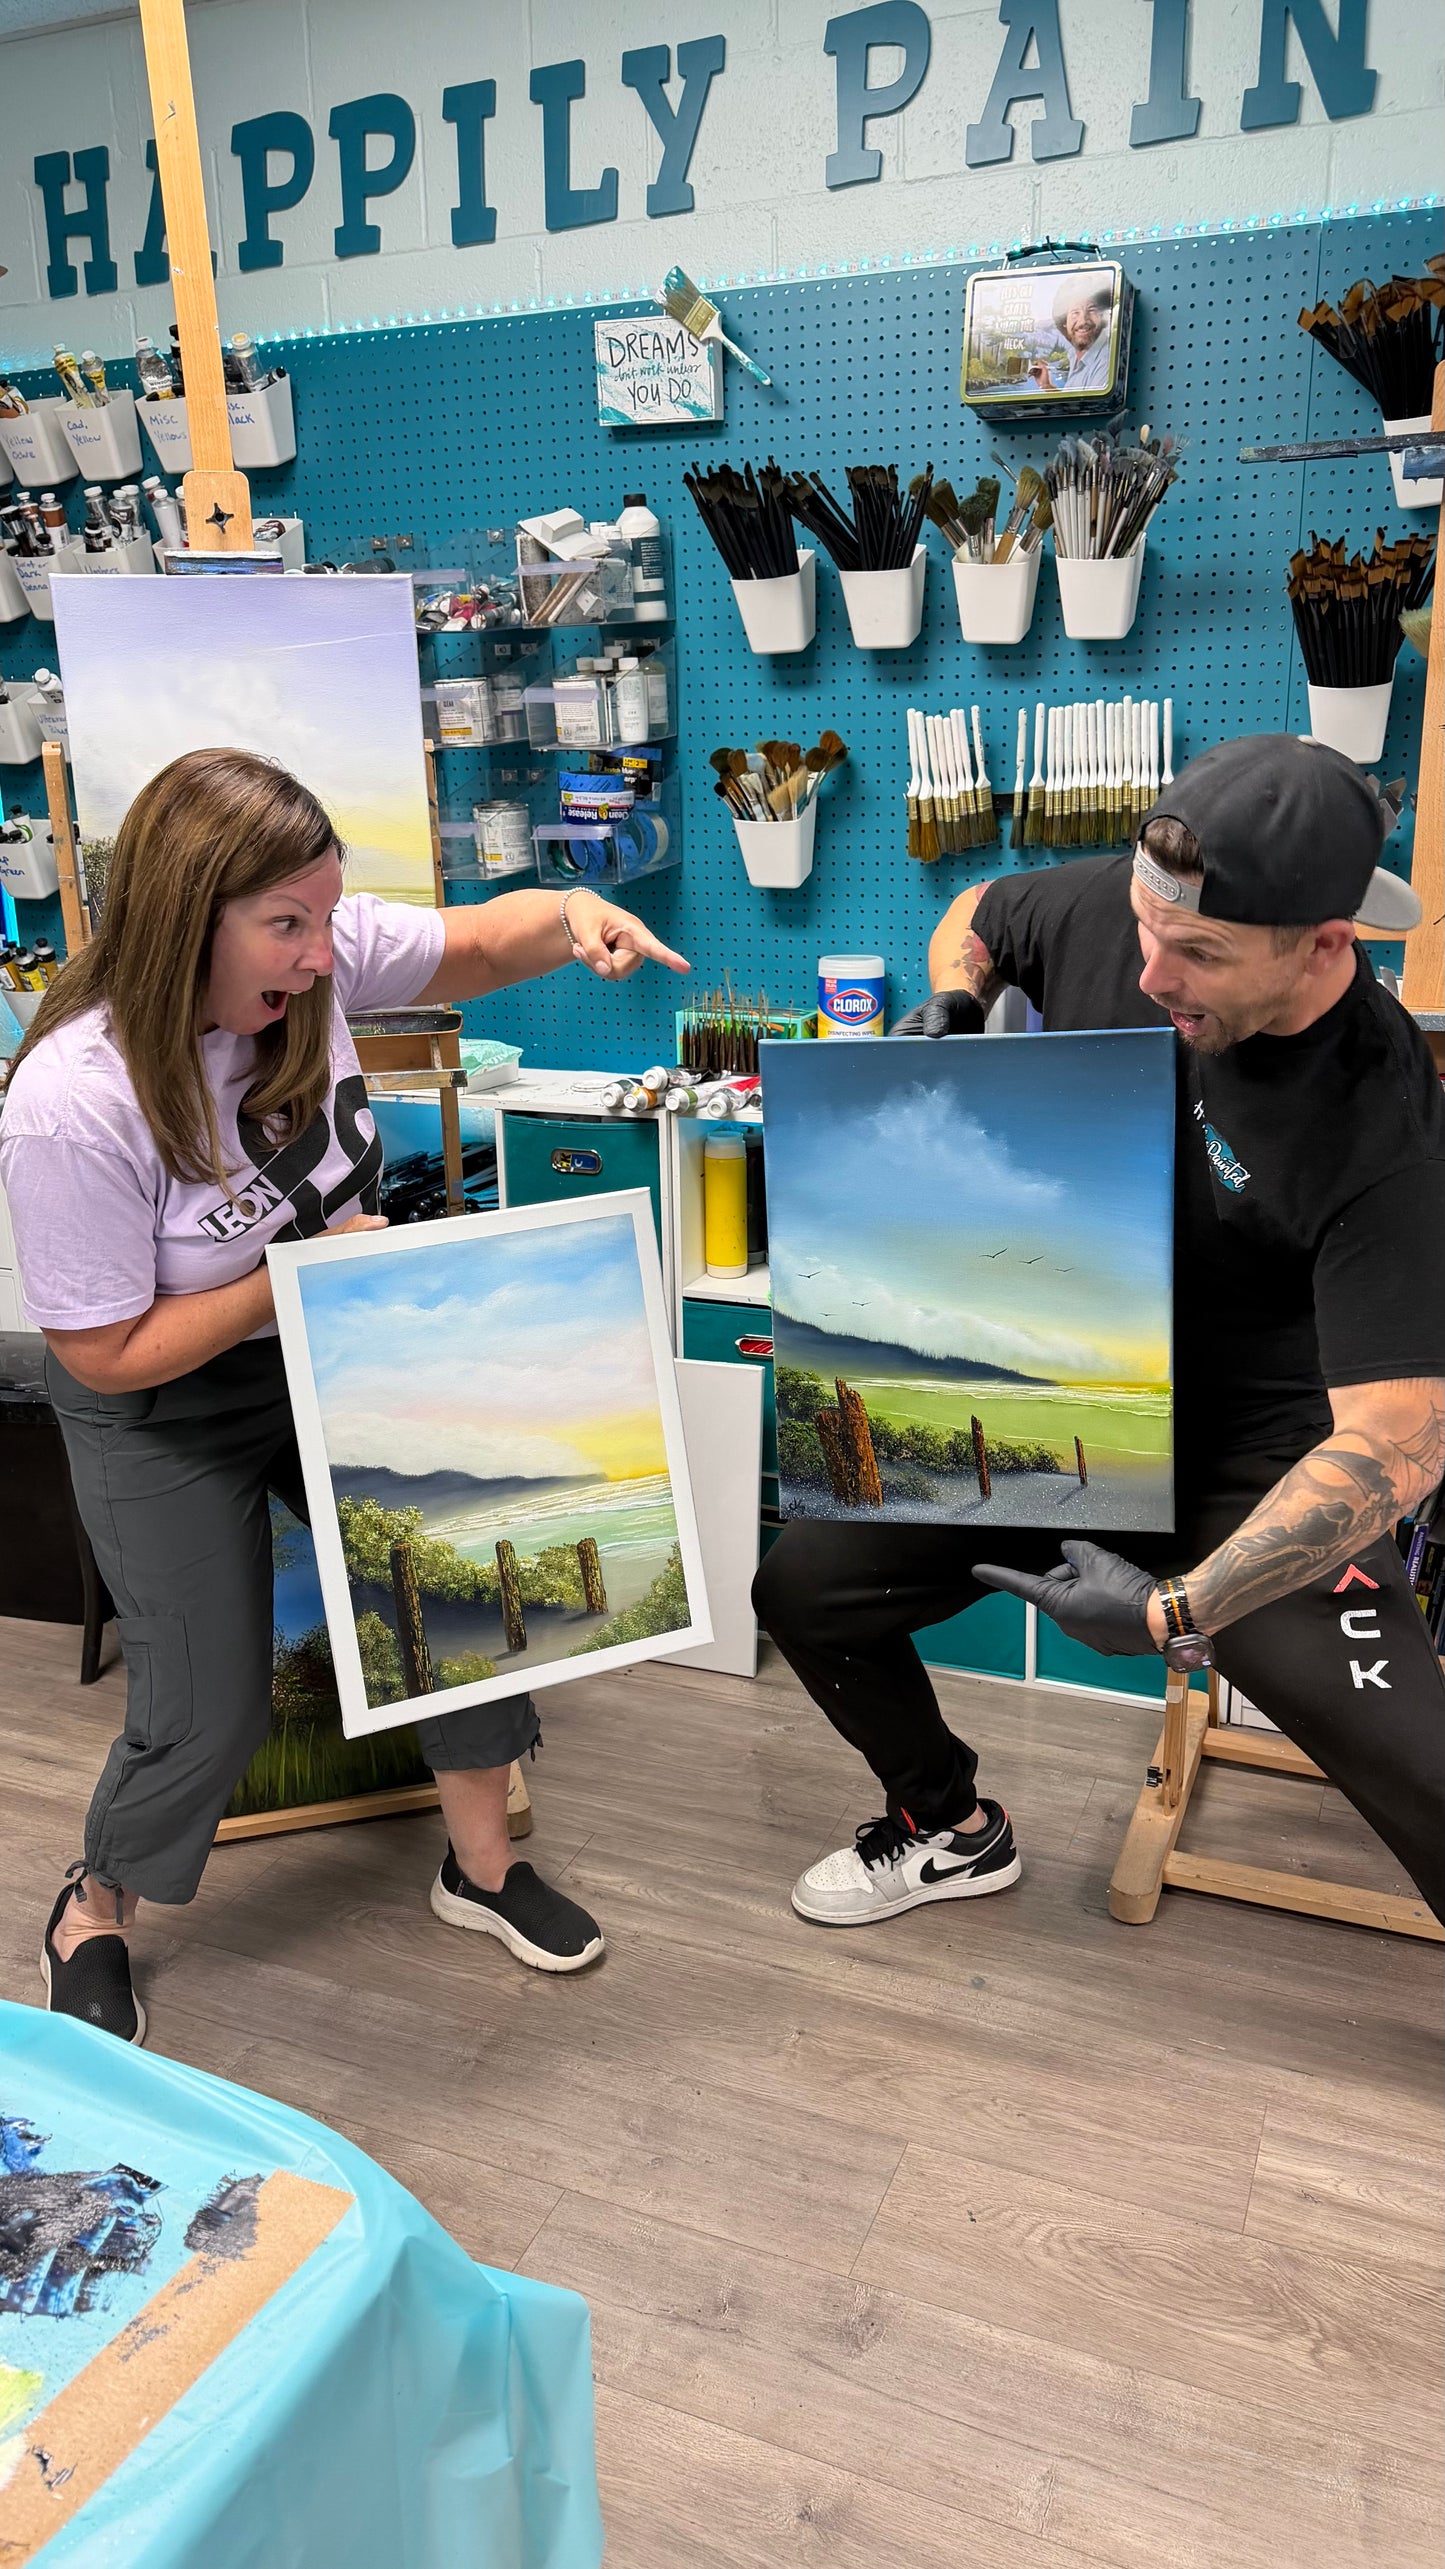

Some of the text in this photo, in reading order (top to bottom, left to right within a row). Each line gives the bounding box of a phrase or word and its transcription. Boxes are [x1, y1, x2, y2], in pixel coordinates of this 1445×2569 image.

[606, 330, 699, 368] DREAMS
[640, 364, 664, 377] work
[667, 362, 701, 374] unless
[627, 378, 692, 410] YOU DO
[227, 402, 245, 410] isc.
[67, 420, 88, 431] Cad.
[227, 412, 255, 425] lack
[72, 434, 101, 446] Yellow
[568, 809, 598, 820] Release
[833, 998, 873, 1013] CLOROX
[1207, 1140, 1251, 1189] Painted
[199, 1173, 285, 1238] LEON
